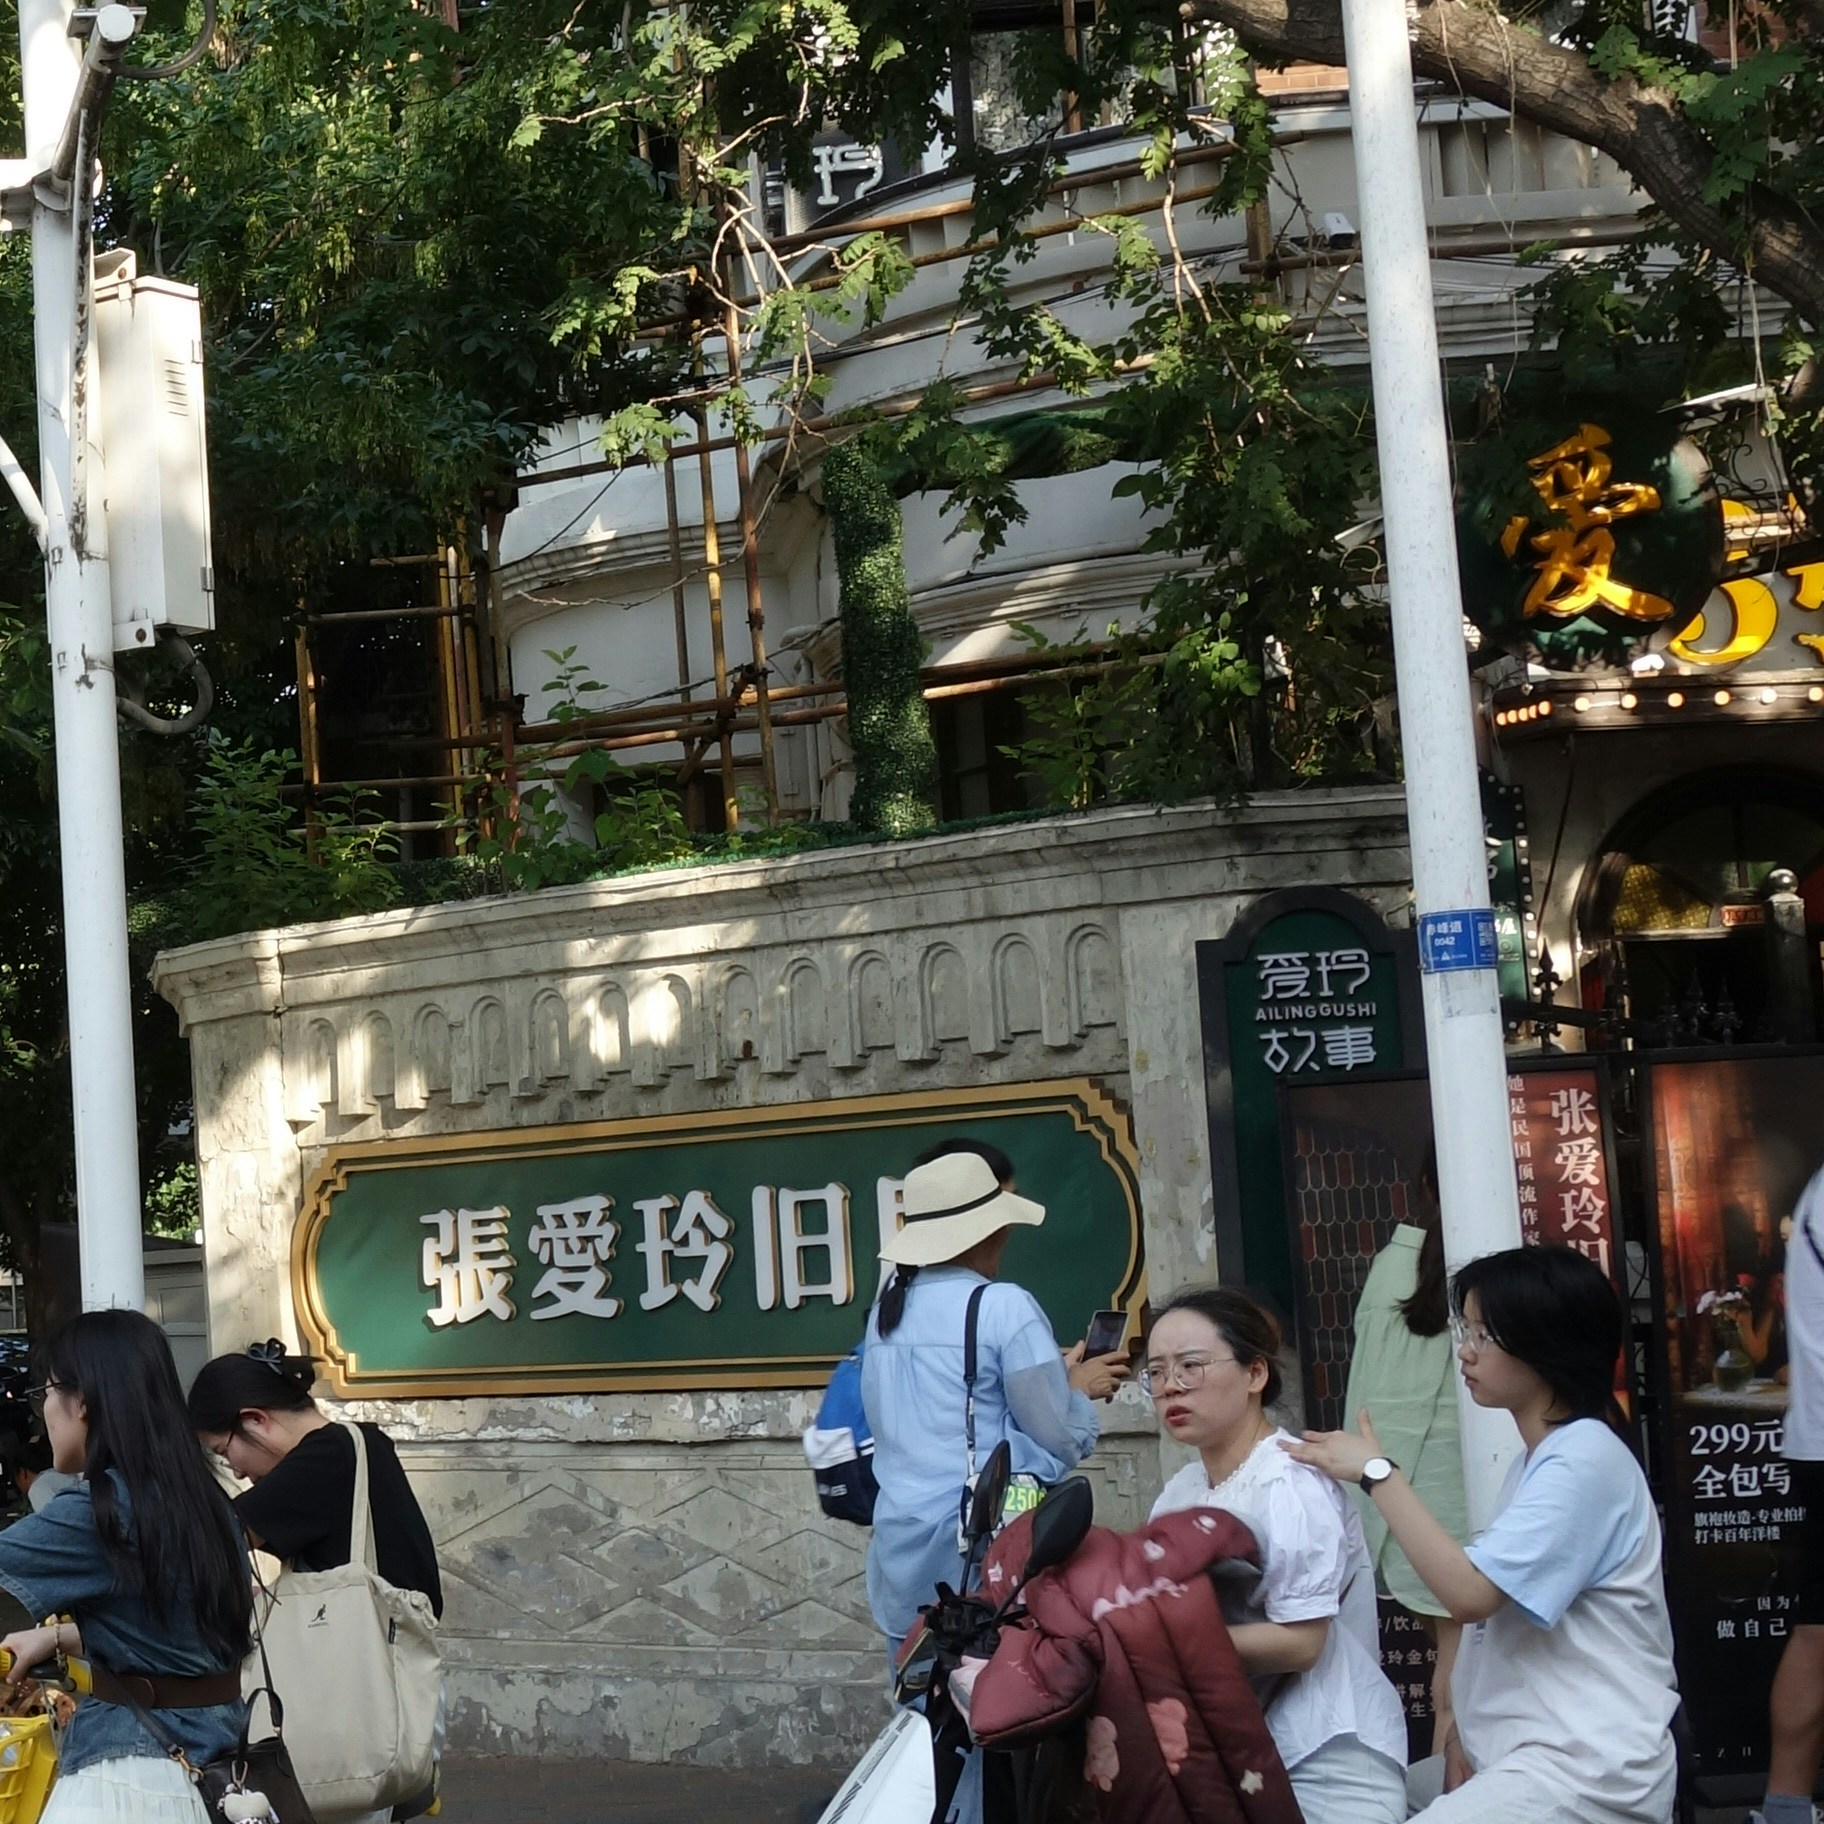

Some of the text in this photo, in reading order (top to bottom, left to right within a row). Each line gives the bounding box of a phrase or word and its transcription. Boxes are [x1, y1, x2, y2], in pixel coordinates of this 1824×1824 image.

[1256, 948, 1372, 1001] 爱玲
[1259, 1024, 1377, 1073] 故事
[419, 1176, 905, 1328] 張愛玲旧
[1689, 1419, 1784, 1456] 299元
[1694, 1525, 1782, 1545] 打卡百年洋楼
[1757, 1594, 1799, 1611] 因为
[1716, 1618, 1788, 1639] 做自己
